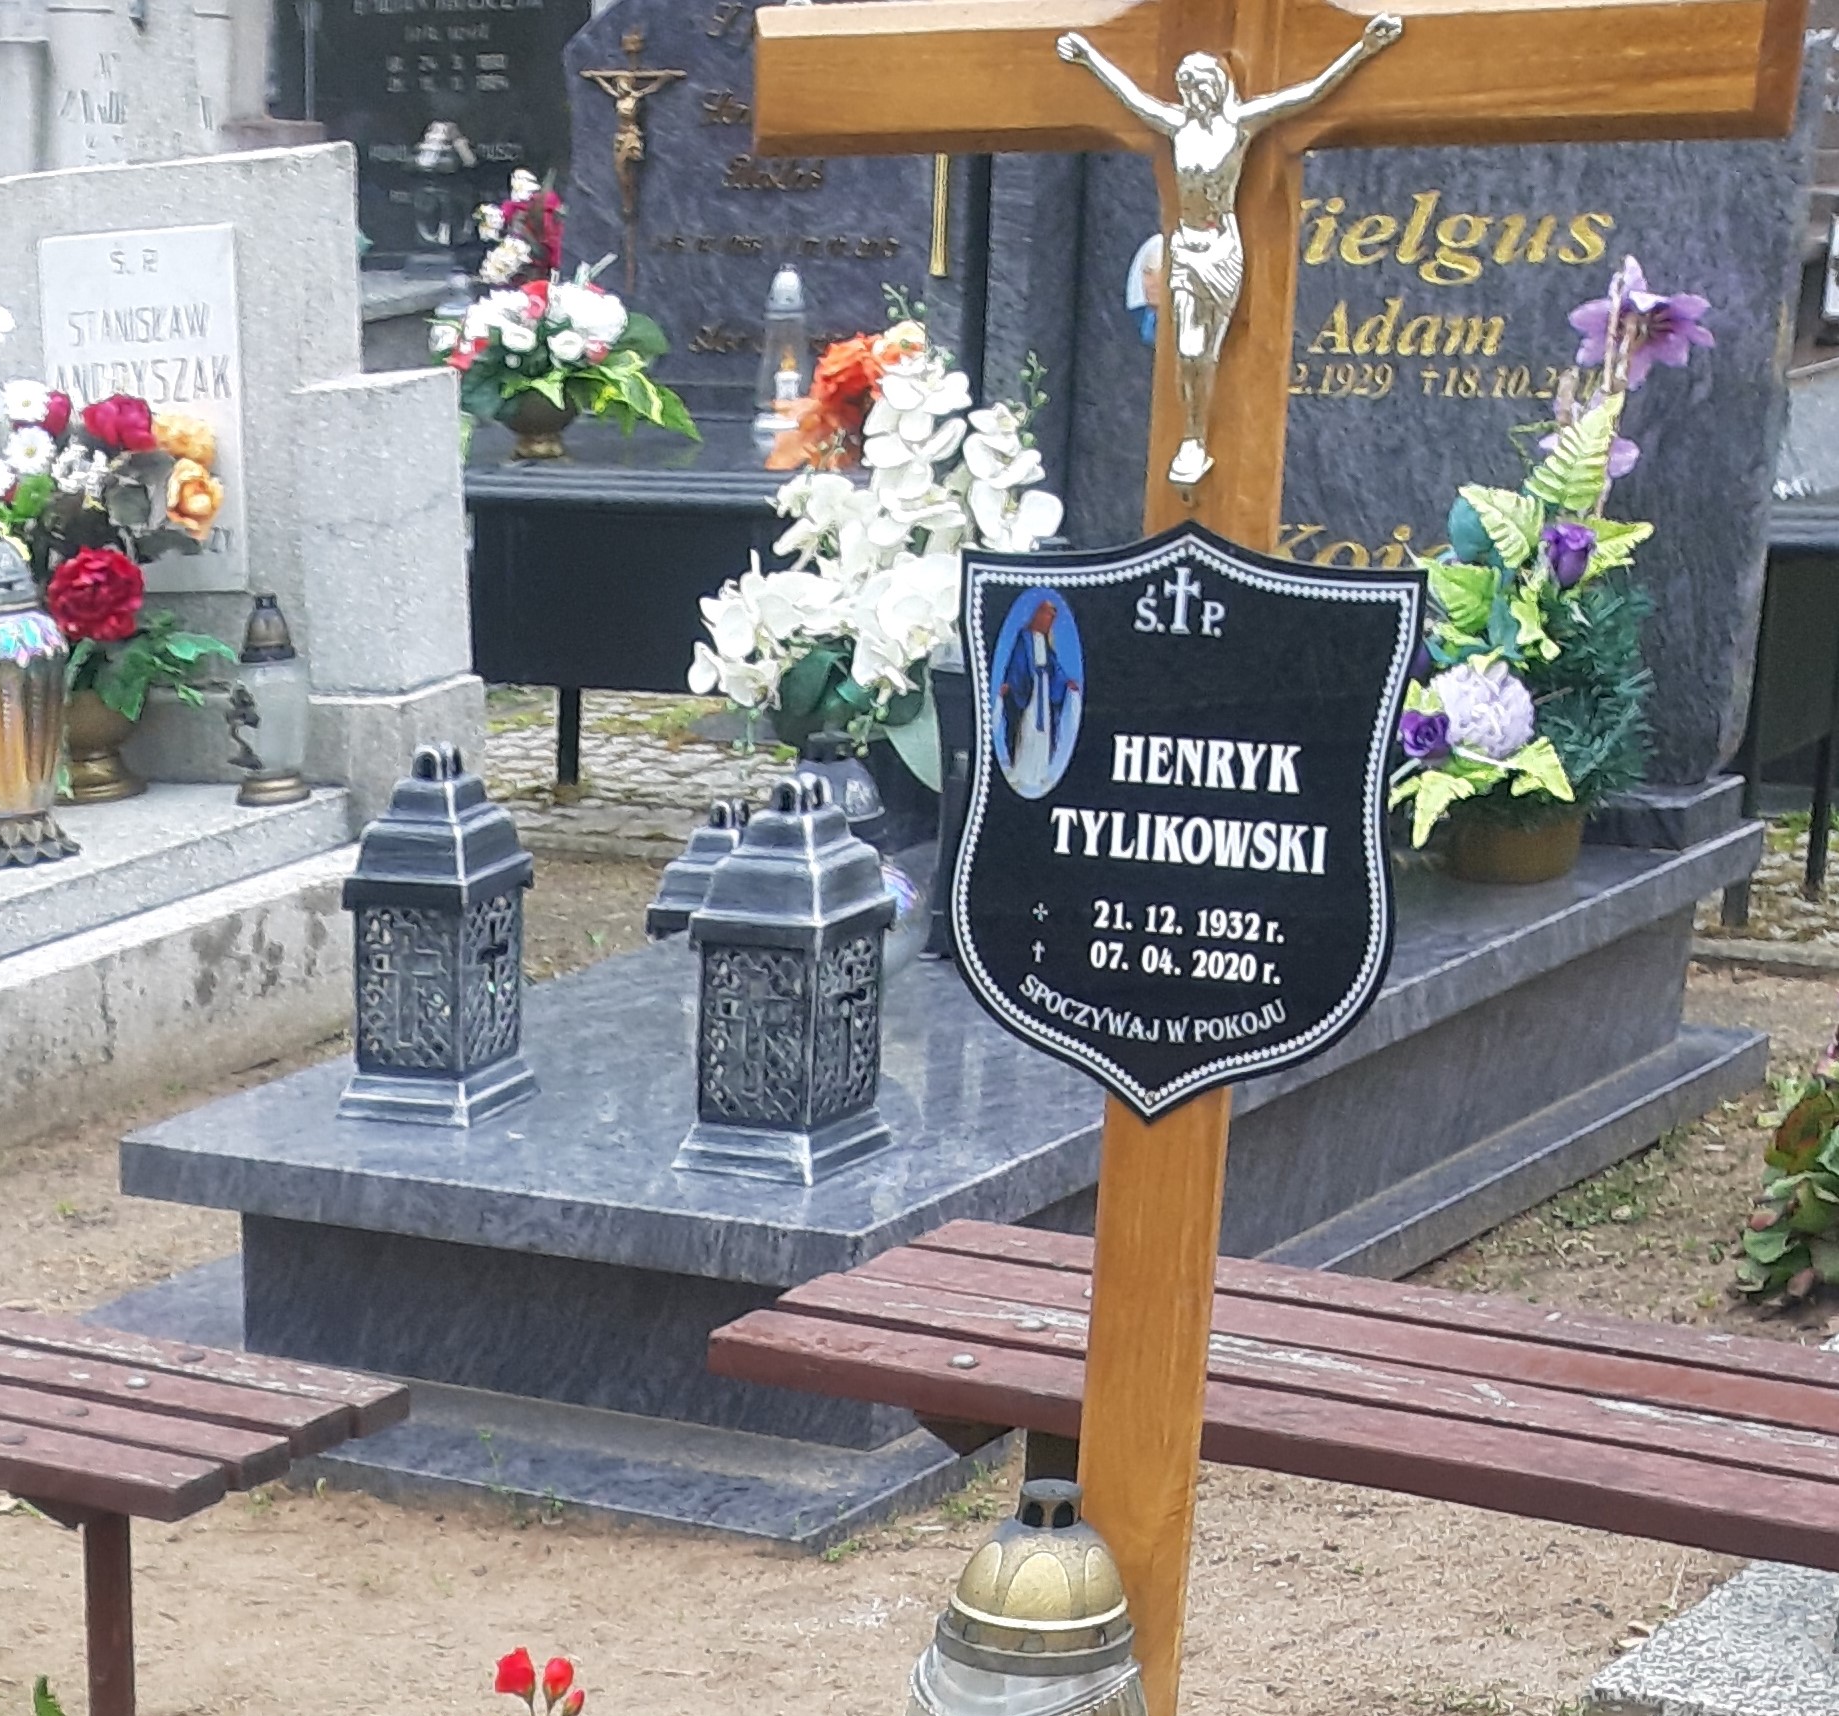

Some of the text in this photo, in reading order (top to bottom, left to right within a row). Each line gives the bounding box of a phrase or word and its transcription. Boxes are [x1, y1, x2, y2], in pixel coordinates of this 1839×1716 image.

[1300, 189, 1615, 286] ielgus
[68, 301, 210, 347] STANISŁAW
[1306, 297, 1506, 357] Adam
[1200, 601, 1227, 638] P.
[1111, 734, 1304, 794] HENRYK
[1049, 806, 1329, 875] TYLIKOWSKI
[1092, 900, 1286, 944] 21. 12. 1932 r.
[1088, 940, 1282, 985] 07. 04. 2020 r.
[1018, 973, 1288, 1044] SPOCZYWAJ W POKOJU
